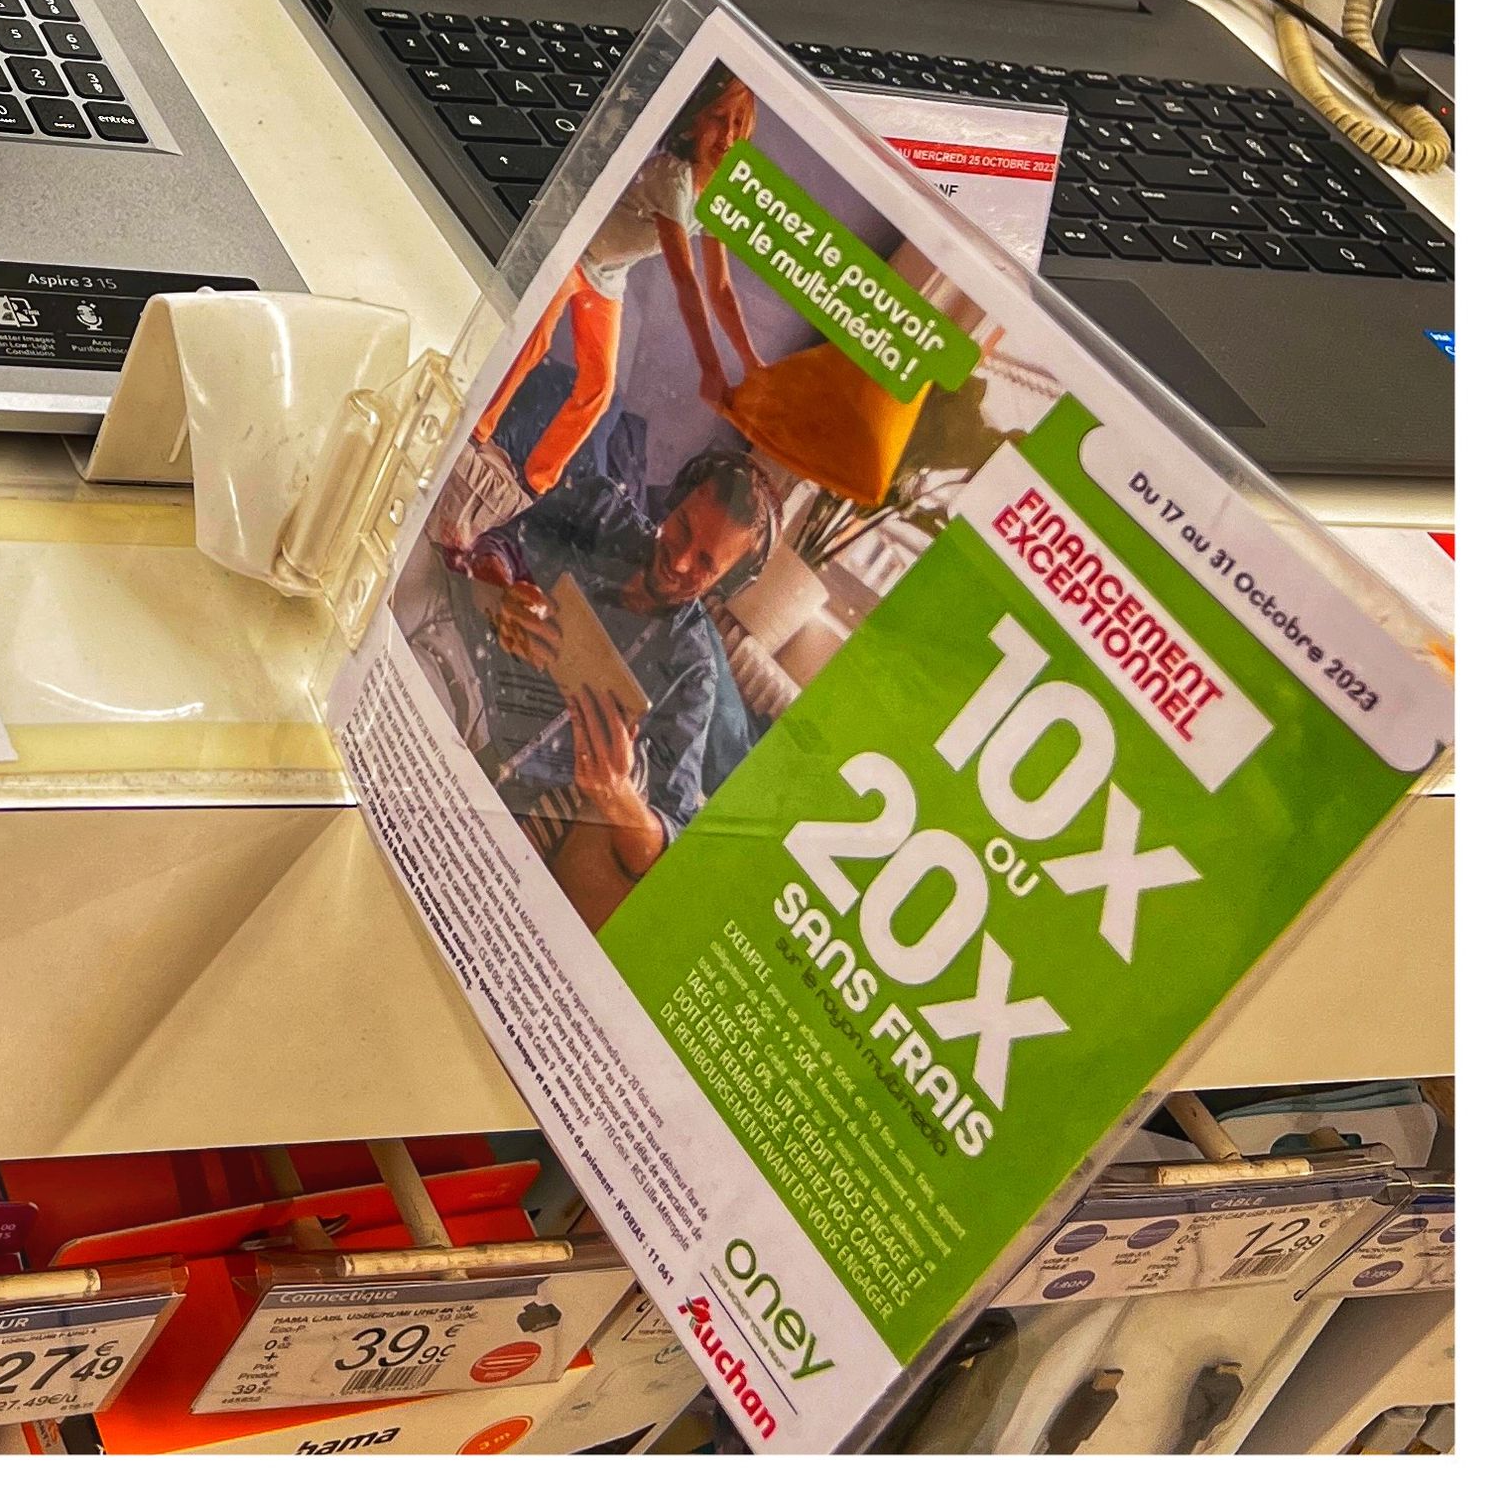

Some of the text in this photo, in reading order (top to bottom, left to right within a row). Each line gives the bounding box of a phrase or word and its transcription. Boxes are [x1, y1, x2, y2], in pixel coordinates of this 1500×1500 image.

[912, 149, 1055, 173] MERCREDI 25 OCTOBRE 2023
[27, 273, 81, 289] Aspire
[708, 192, 903, 372] sur le multimédia
[728, 158, 948, 355] Prenez le pouvoir
[991, 504, 1195, 743] EXCEPTIONNEL
[1015, 487, 1224, 710] FINANCEMENT
[1128, 470, 1380, 714] Du 17 au 31 Octobre 2023
[933, 612, 1203, 965] 10X
[783, 750, 1071, 1112] 20X
[983, 835, 1040, 898] OU
[723, 918, 773, 984] EXEMPLE
[772, 880, 878, 1014] SANS
[869, 1002, 994, 1159] FRAIS
[672, 1023, 896, 1320] REMBOURSEMENT ENGAGER
[682, 969, 715, 1007] TAEG
[708, 1004, 743, 1045] FIXES
[735, 1041, 758, 1065] DE
[771, 1089, 797, 1117] UN
[789, 1112, 838, 1169] CRÉDIT
[827, 1164, 865, 1209] VOUS
[858, 1206, 911, 1269] ENGAGE
[904, 1267, 926, 1290] ET
[1210, 1196, 1265, 1208] CABLE
[779, 1133, 833, 1199] VÉRIFIEZ
[822, 1193, 855, 1230] VOS
[846, 1225, 914, 1307] CAPACITÉS
[1234, 1218, 1311, 1259] 12
[70, 1355, 124, 1382] 49
[279, 1290, 398, 1304] Connectique
[334, 1324, 430, 1372] 39
[677, 1295, 778, 1440] Auchan
[725, 1238, 835, 1380] oney
[294, 1426, 402, 1455] hama
